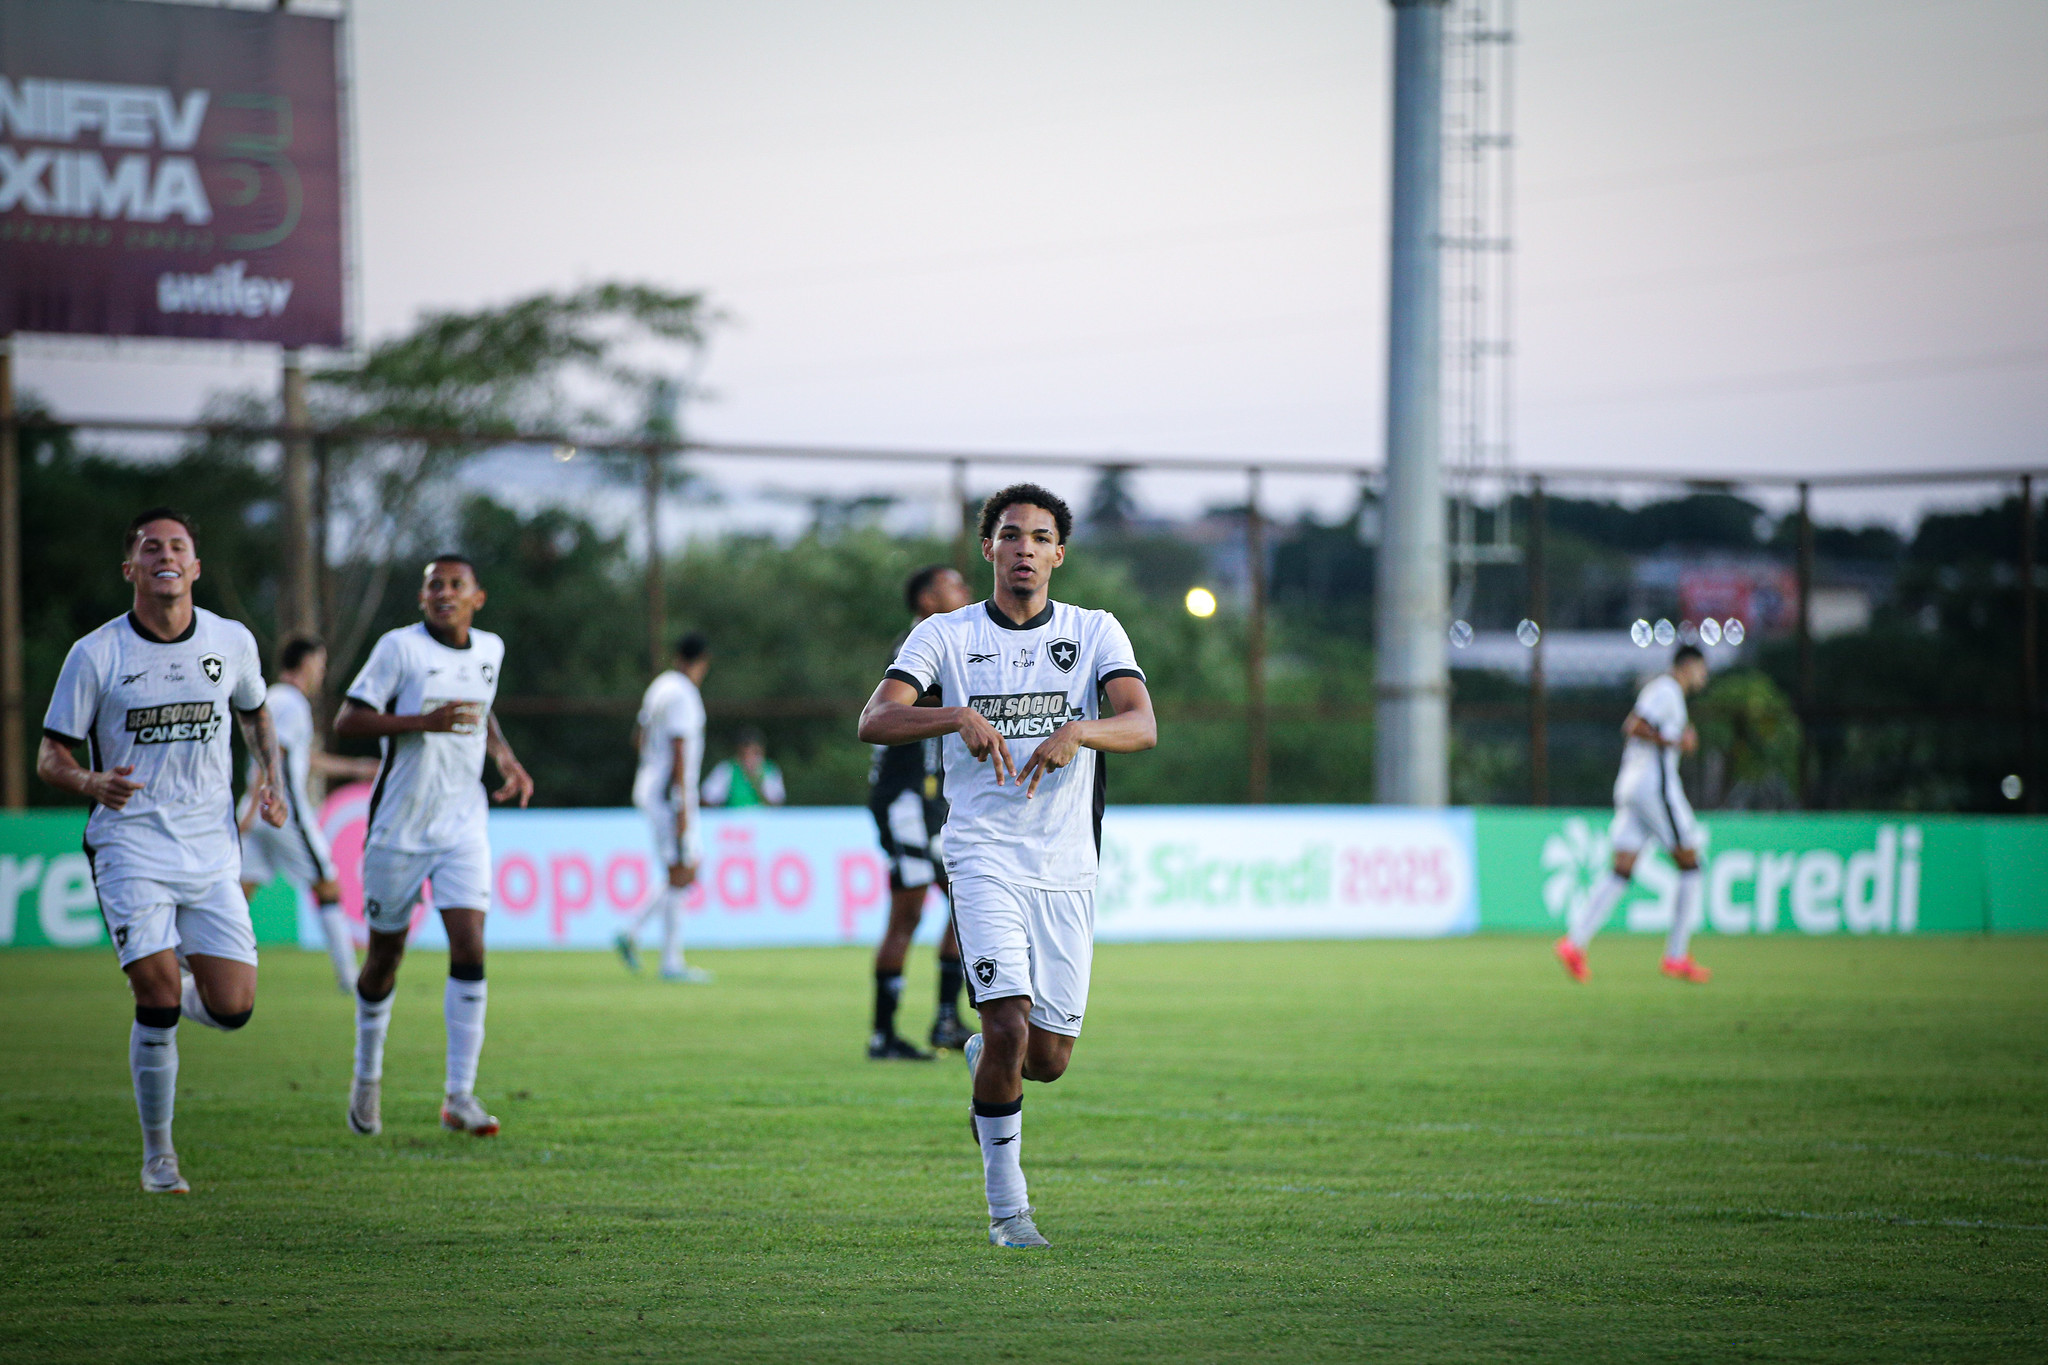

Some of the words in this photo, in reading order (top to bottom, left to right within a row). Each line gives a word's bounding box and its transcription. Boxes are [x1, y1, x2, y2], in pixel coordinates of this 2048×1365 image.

[971, 697, 1001, 717] SEJA
[1004, 692, 1063, 716] SÓCIO
[130, 709, 158, 727] SEJA
[1150, 843, 1332, 906] Sicredi
[1341, 847, 1453, 904] 2025
